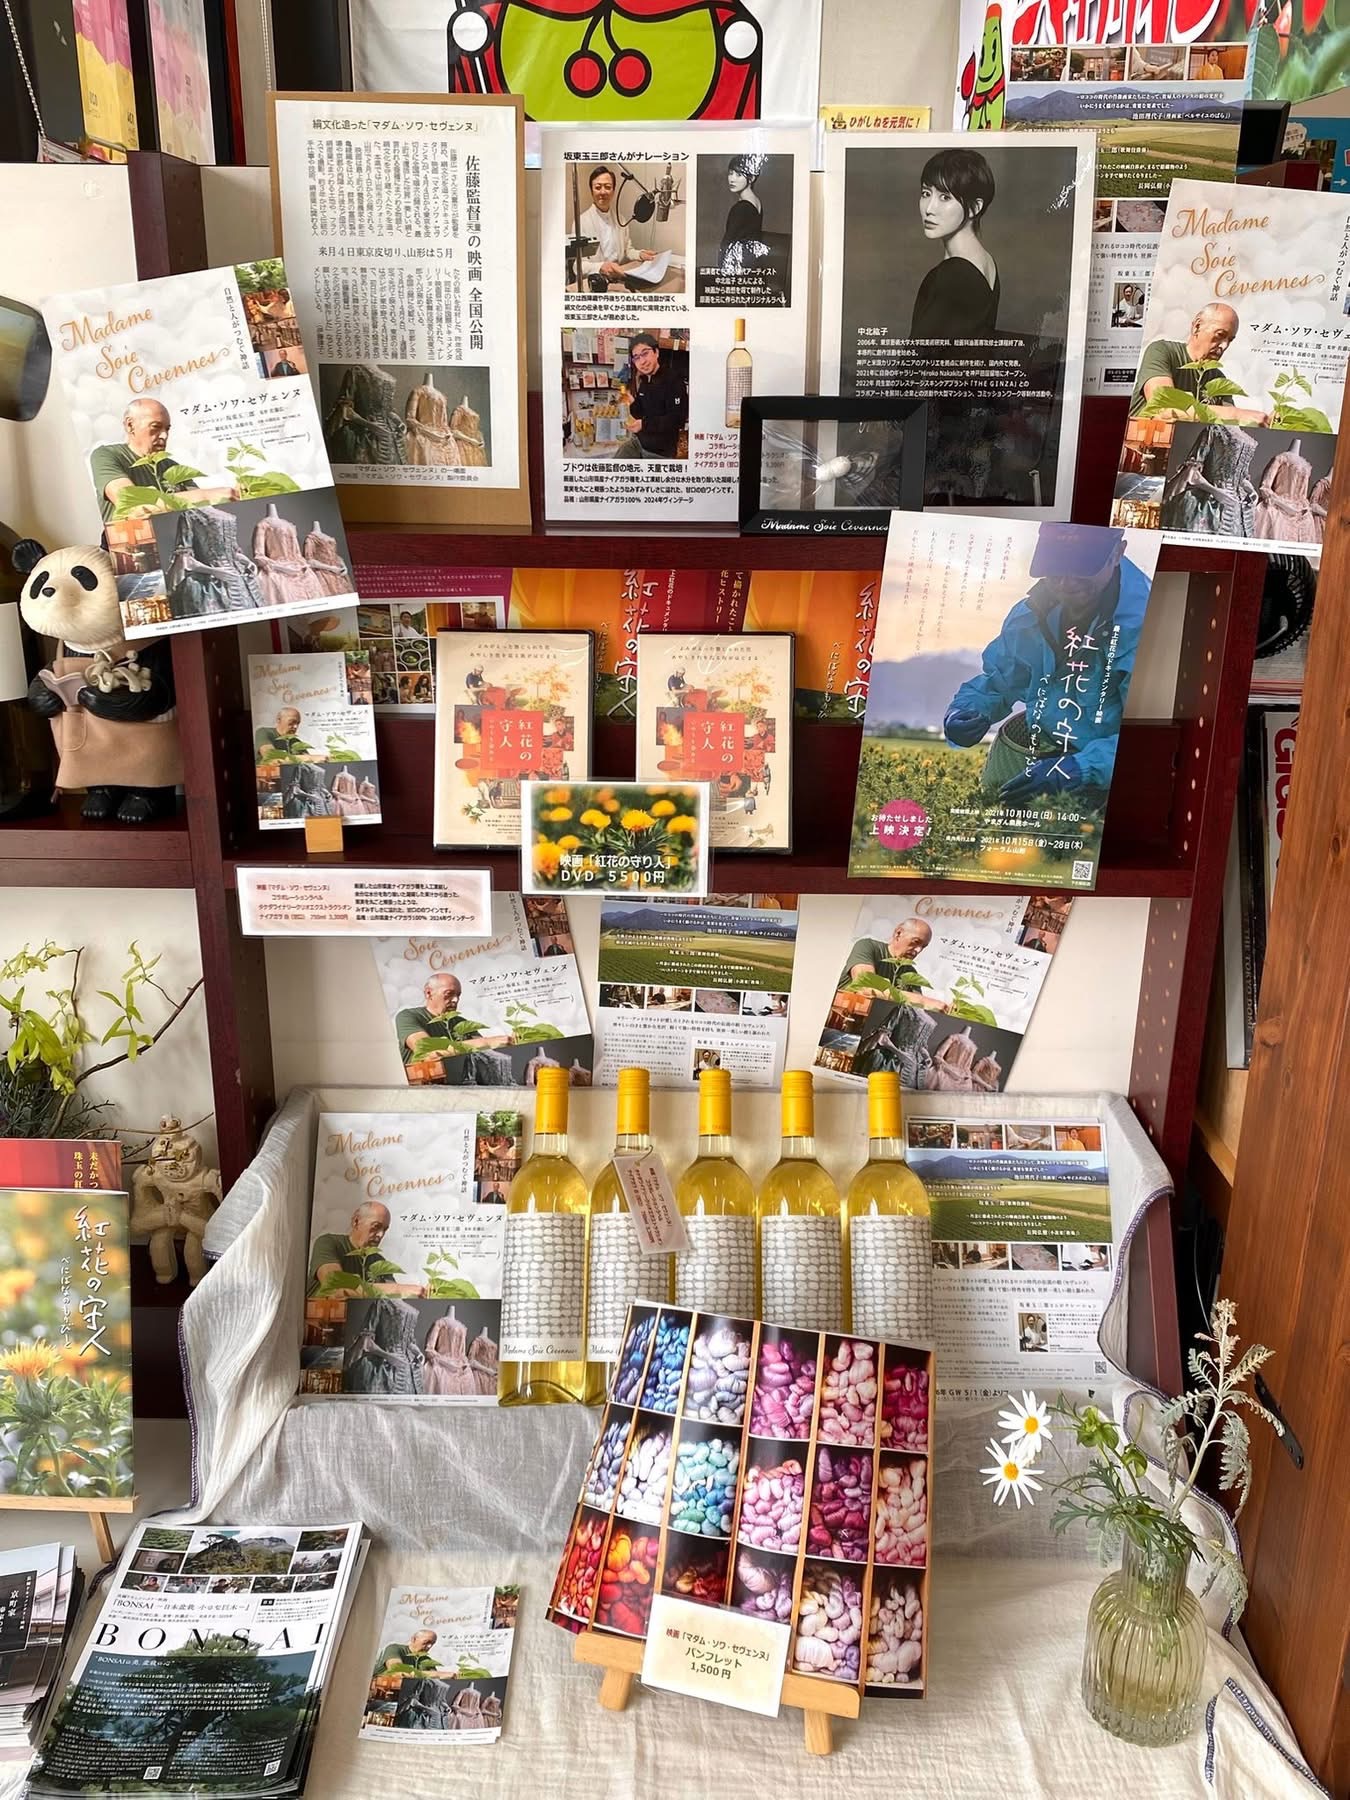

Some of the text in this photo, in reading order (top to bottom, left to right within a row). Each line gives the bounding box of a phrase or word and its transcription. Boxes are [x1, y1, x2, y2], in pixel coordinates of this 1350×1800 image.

[312, 119, 479, 132] 絹文化追った「マダム・ソワ・セヴェンヌ」
[564, 152, 690, 162] 坂東玉三郎さんがナレーション
[1172, 208, 1270, 238] Madame
[318, 247, 453, 260] 来月4日東京皮切り、山形は5月
[1191, 242, 1236, 276] Soie
[58, 307, 153, 352] Madame
[468, 288, 484, 350] 全国公開
[96, 343, 138, 380] Soie
[761, 518, 810, 530] Madame
[814, 519, 837, 532] Soie
[1046, 626, 1099, 780] 紅花の守人
[871, 813, 933, 824] お待たせしました
[869, 825, 933, 837] 上映決定!
[560, 855, 671, 869] 映画「紅花の守り人」
[561, 871, 665, 883] DVD 5500円
[326, 1130, 404, 1156] Madame
[74, 1205, 111, 1356] 紅花の守人
[92, 1623, 332, 1650] BONSAI
[666, 1627, 770, 1661] 映画「マダム・ソワ・セヴェンヌ」
[685, 1647, 742, 1668] パンフレット
[690, 1662, 732, 1680] 1,500円
